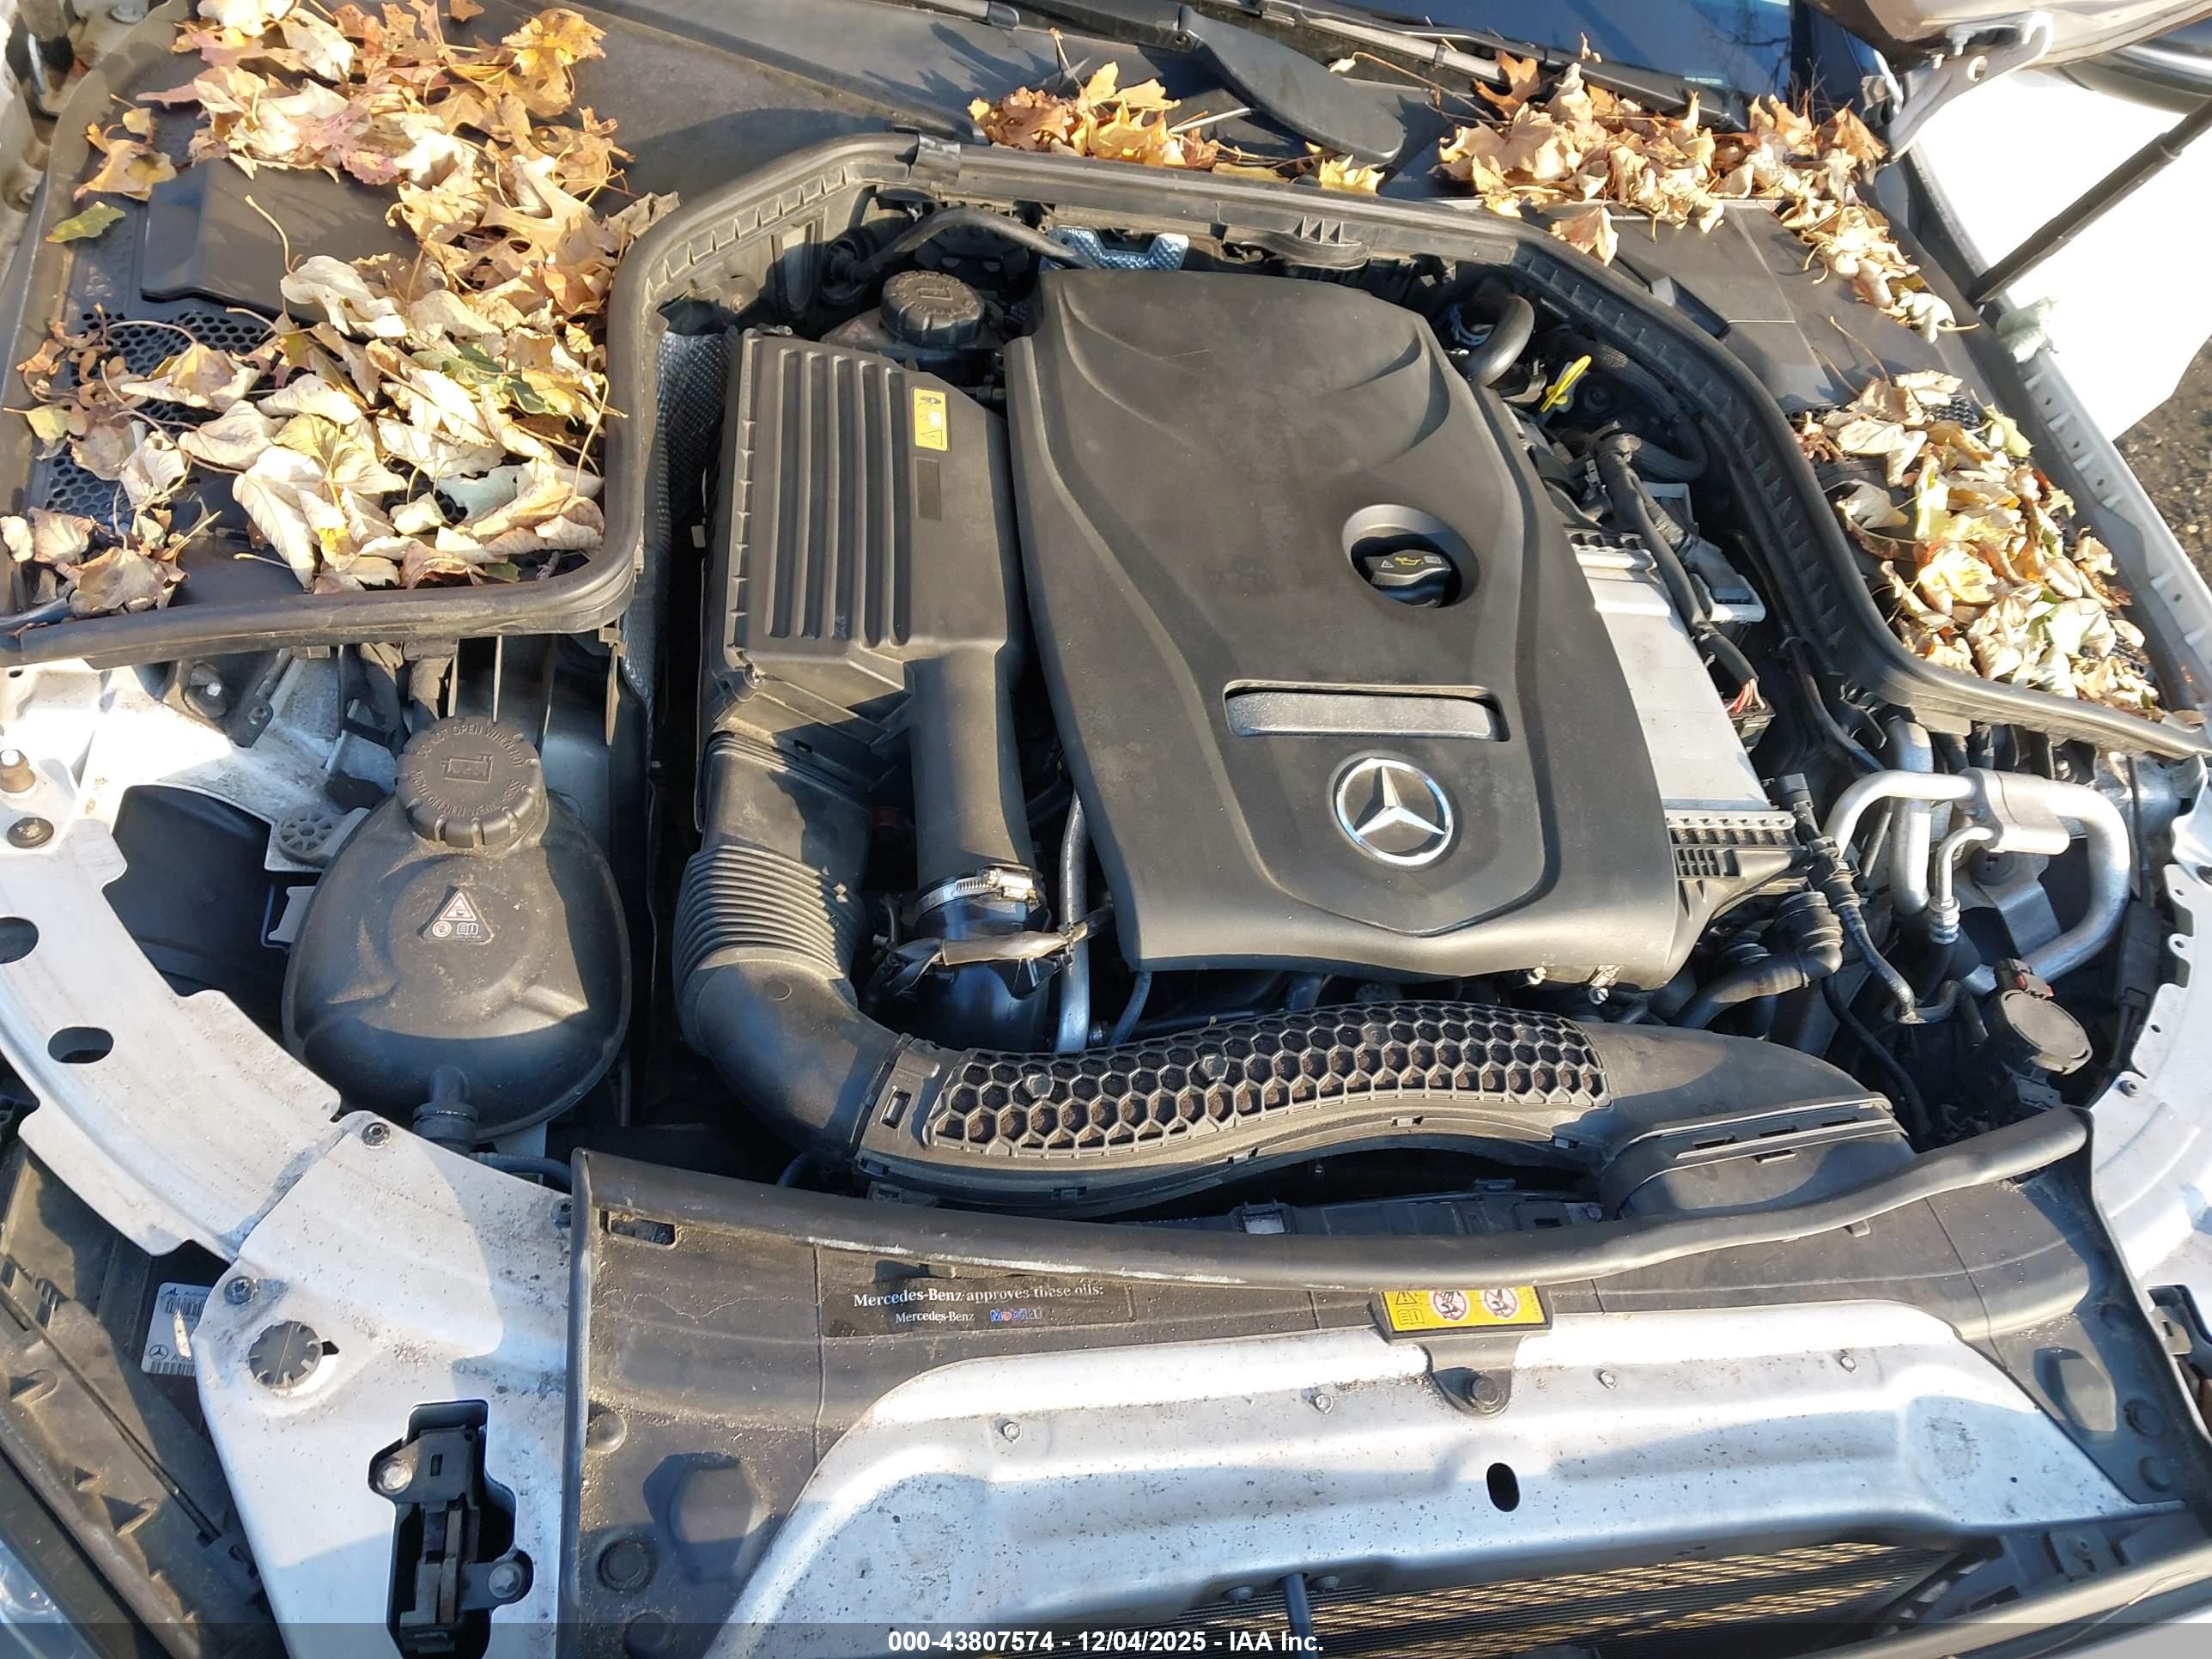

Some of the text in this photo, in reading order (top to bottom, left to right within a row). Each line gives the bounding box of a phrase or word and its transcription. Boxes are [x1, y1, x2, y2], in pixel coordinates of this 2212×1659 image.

[452, 724, 483, 737] OPEN
[485, 726, 514, 751] WHEN
[508, 749, 524, 769] HOT
[853, 1283, 1104, 1308] Mercedes-Benz approves these oils:
[895, 1310, 975, 1324] Mercedes-Benz
